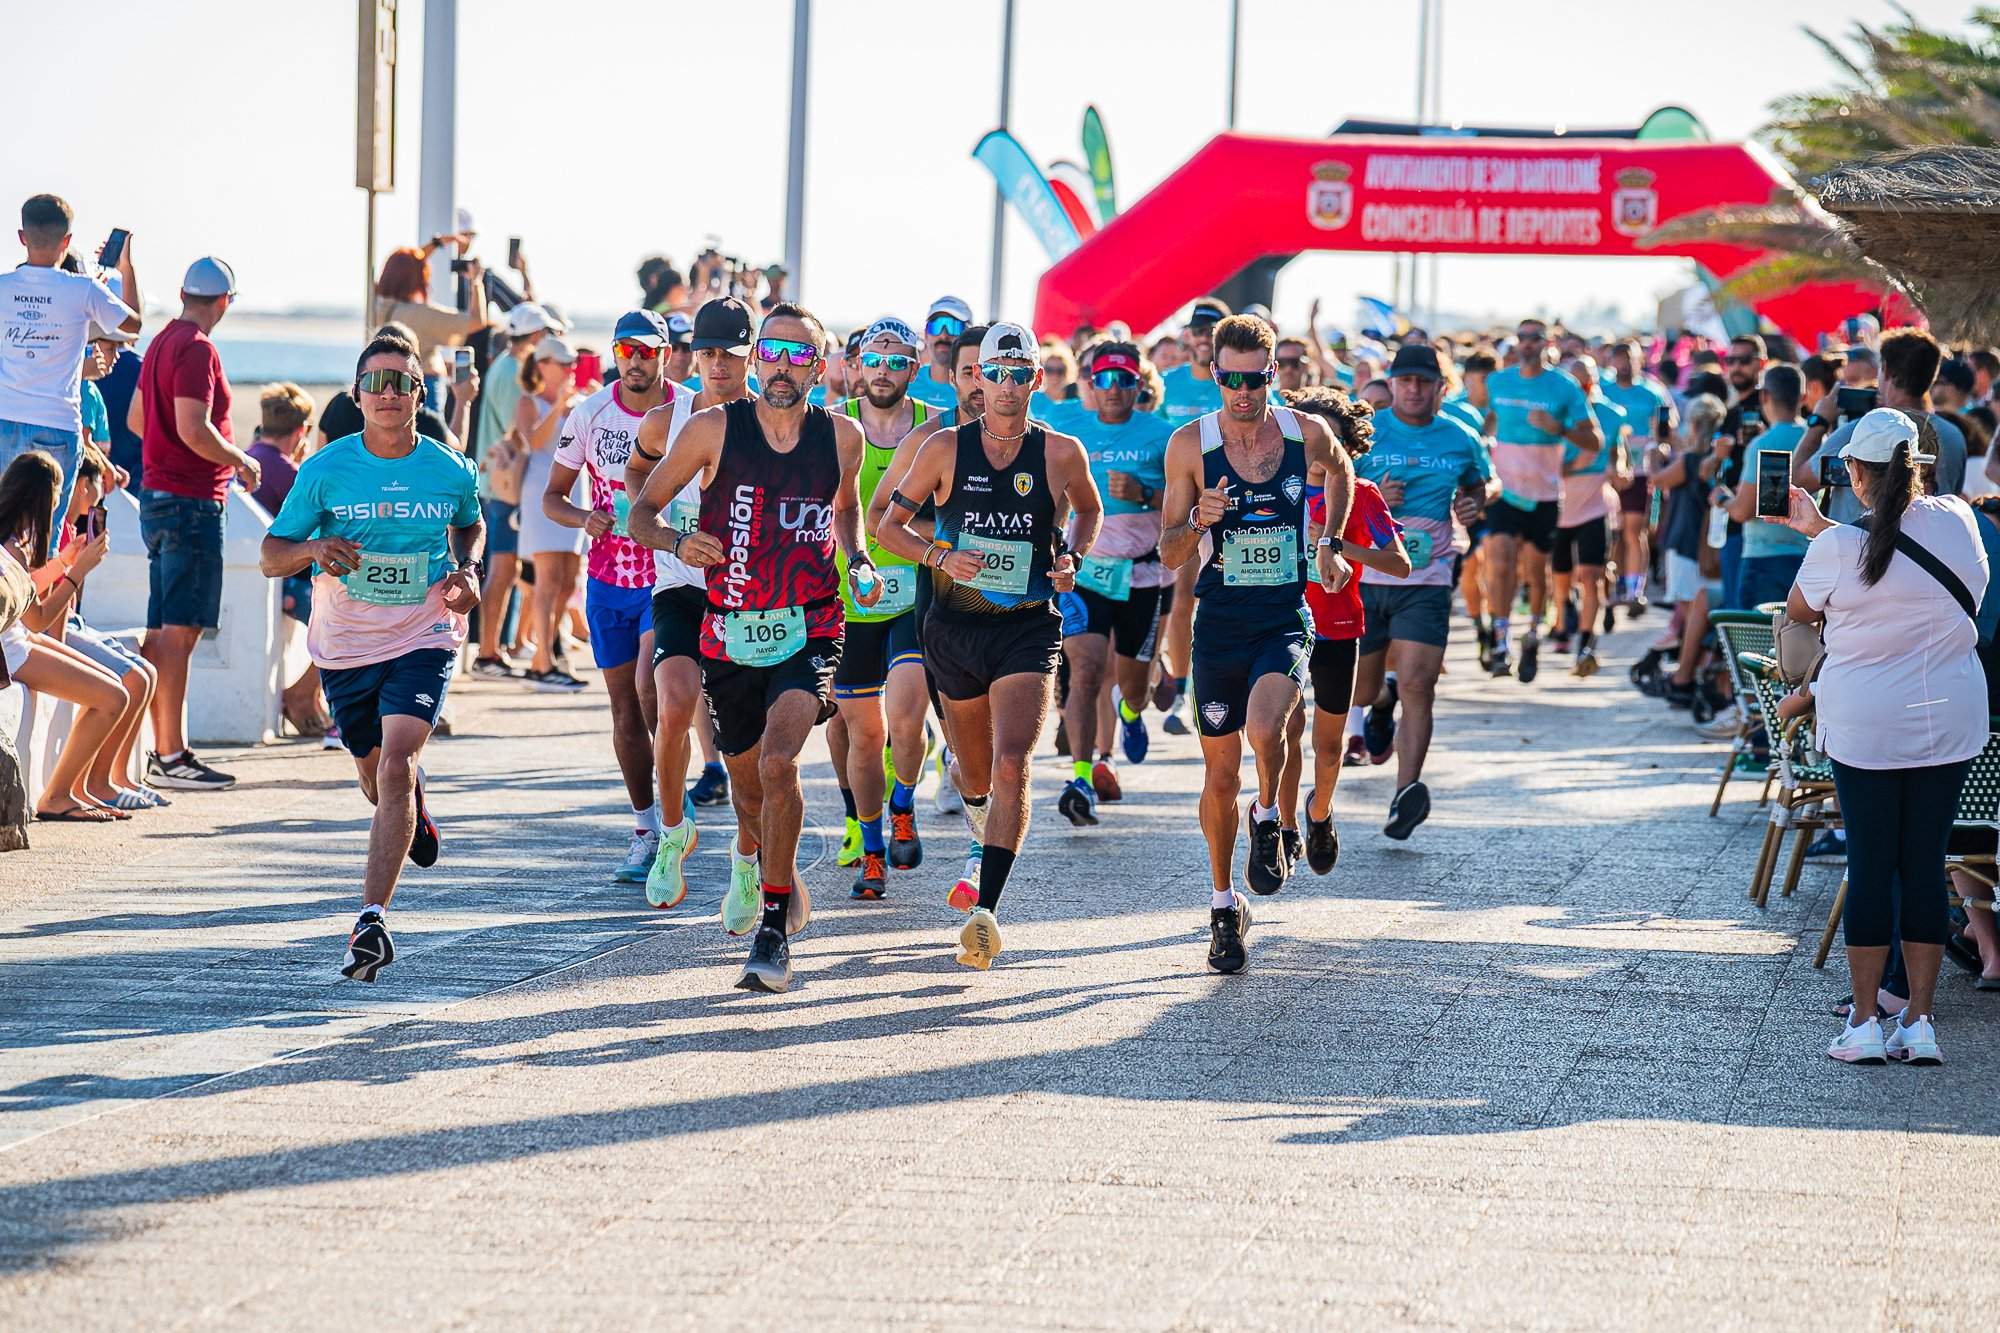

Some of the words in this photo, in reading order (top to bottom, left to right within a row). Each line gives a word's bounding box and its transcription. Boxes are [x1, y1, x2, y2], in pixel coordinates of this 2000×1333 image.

[1477, 206, 1503, 243] DE
[1505, 207, 1602, 245] DEPORTES
[14, 295, 52, 304] MCKENZIE
[750, 487, 765, 546] eventos
[964, 511, 1033, 528] PLAYAS
[723, 484, 755, 607] tripasión
[1240, 546, 1282, 564] 189
[366, 566, 411, 585] 231
[743, 622, 787, 643] 106
